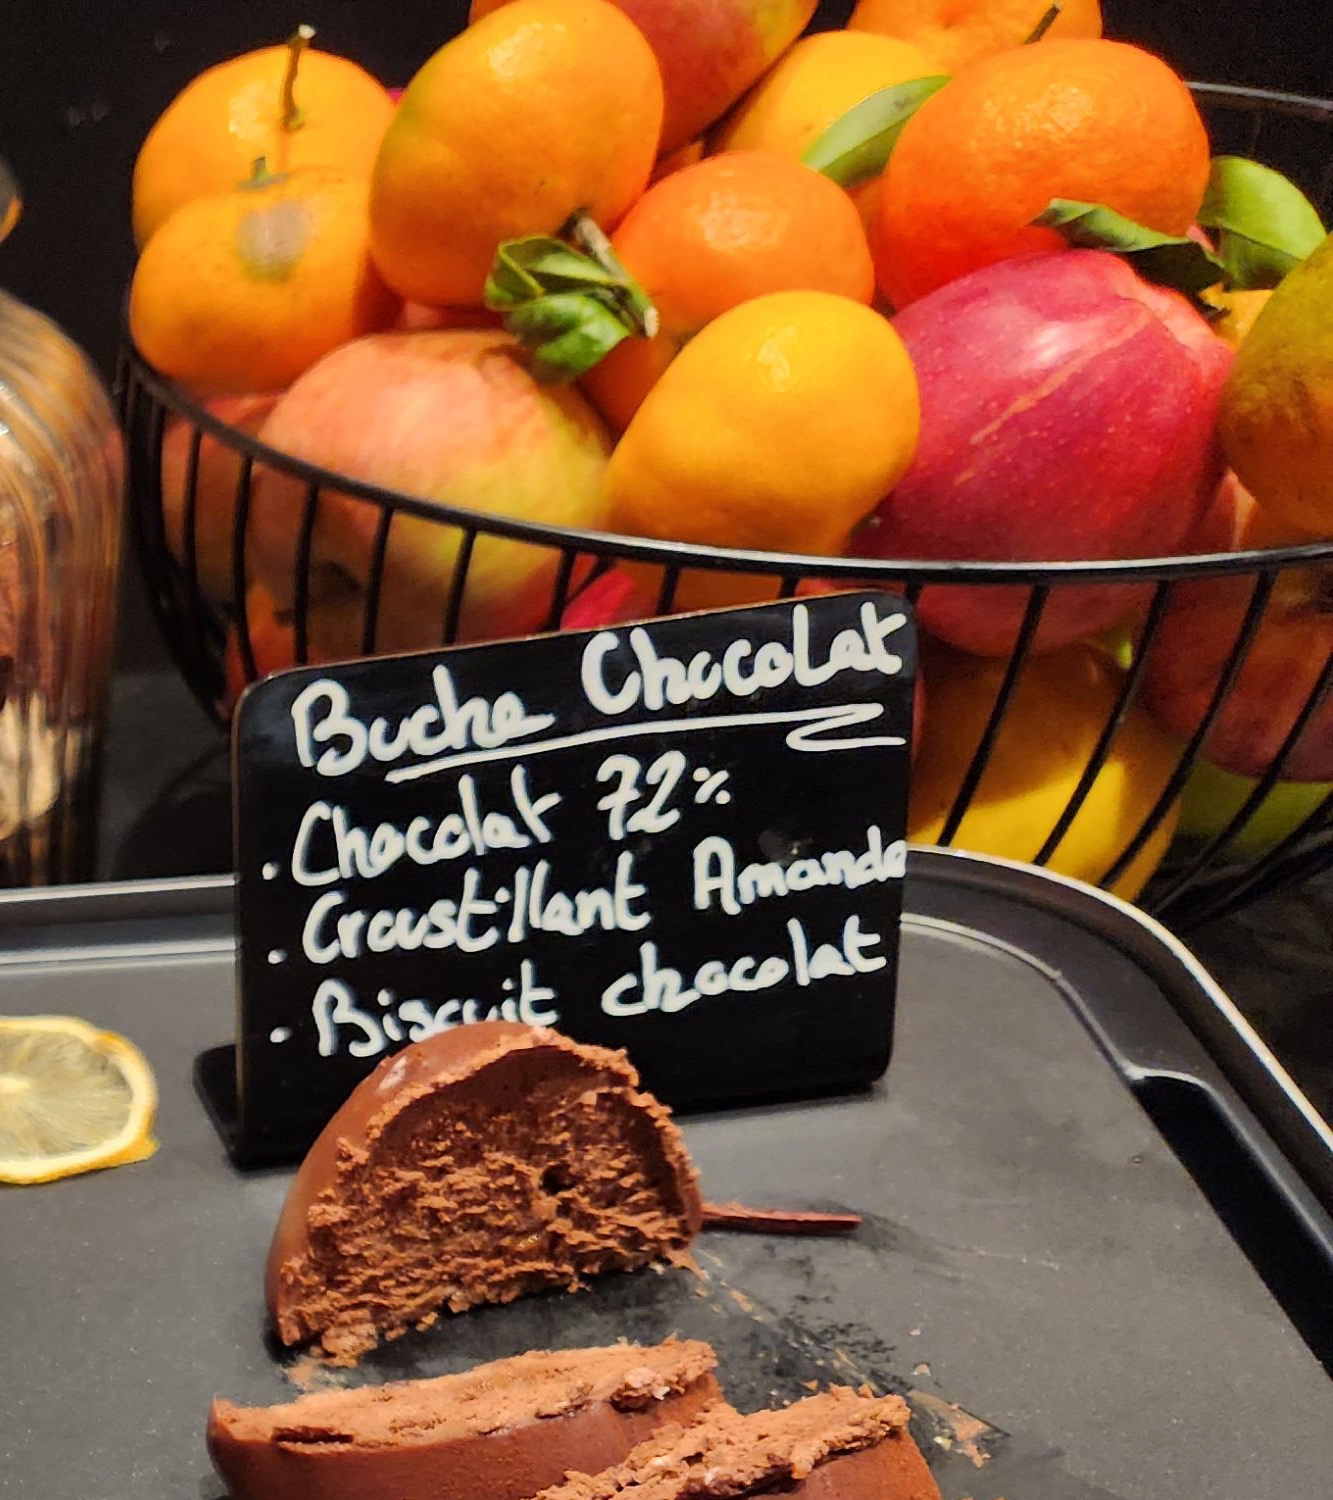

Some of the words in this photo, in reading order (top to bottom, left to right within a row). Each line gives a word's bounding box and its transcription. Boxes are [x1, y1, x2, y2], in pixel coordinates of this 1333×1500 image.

[290, 665, 555, 776] Buche
[581, 603, 907, 716] Chocolat
[291, 765, 562, 887] Chocolat
[693, 825, 907, 915] Amande
[311, 958, 560, 1058] Biscuit
[601, 915, 888, 1018] chocolat
